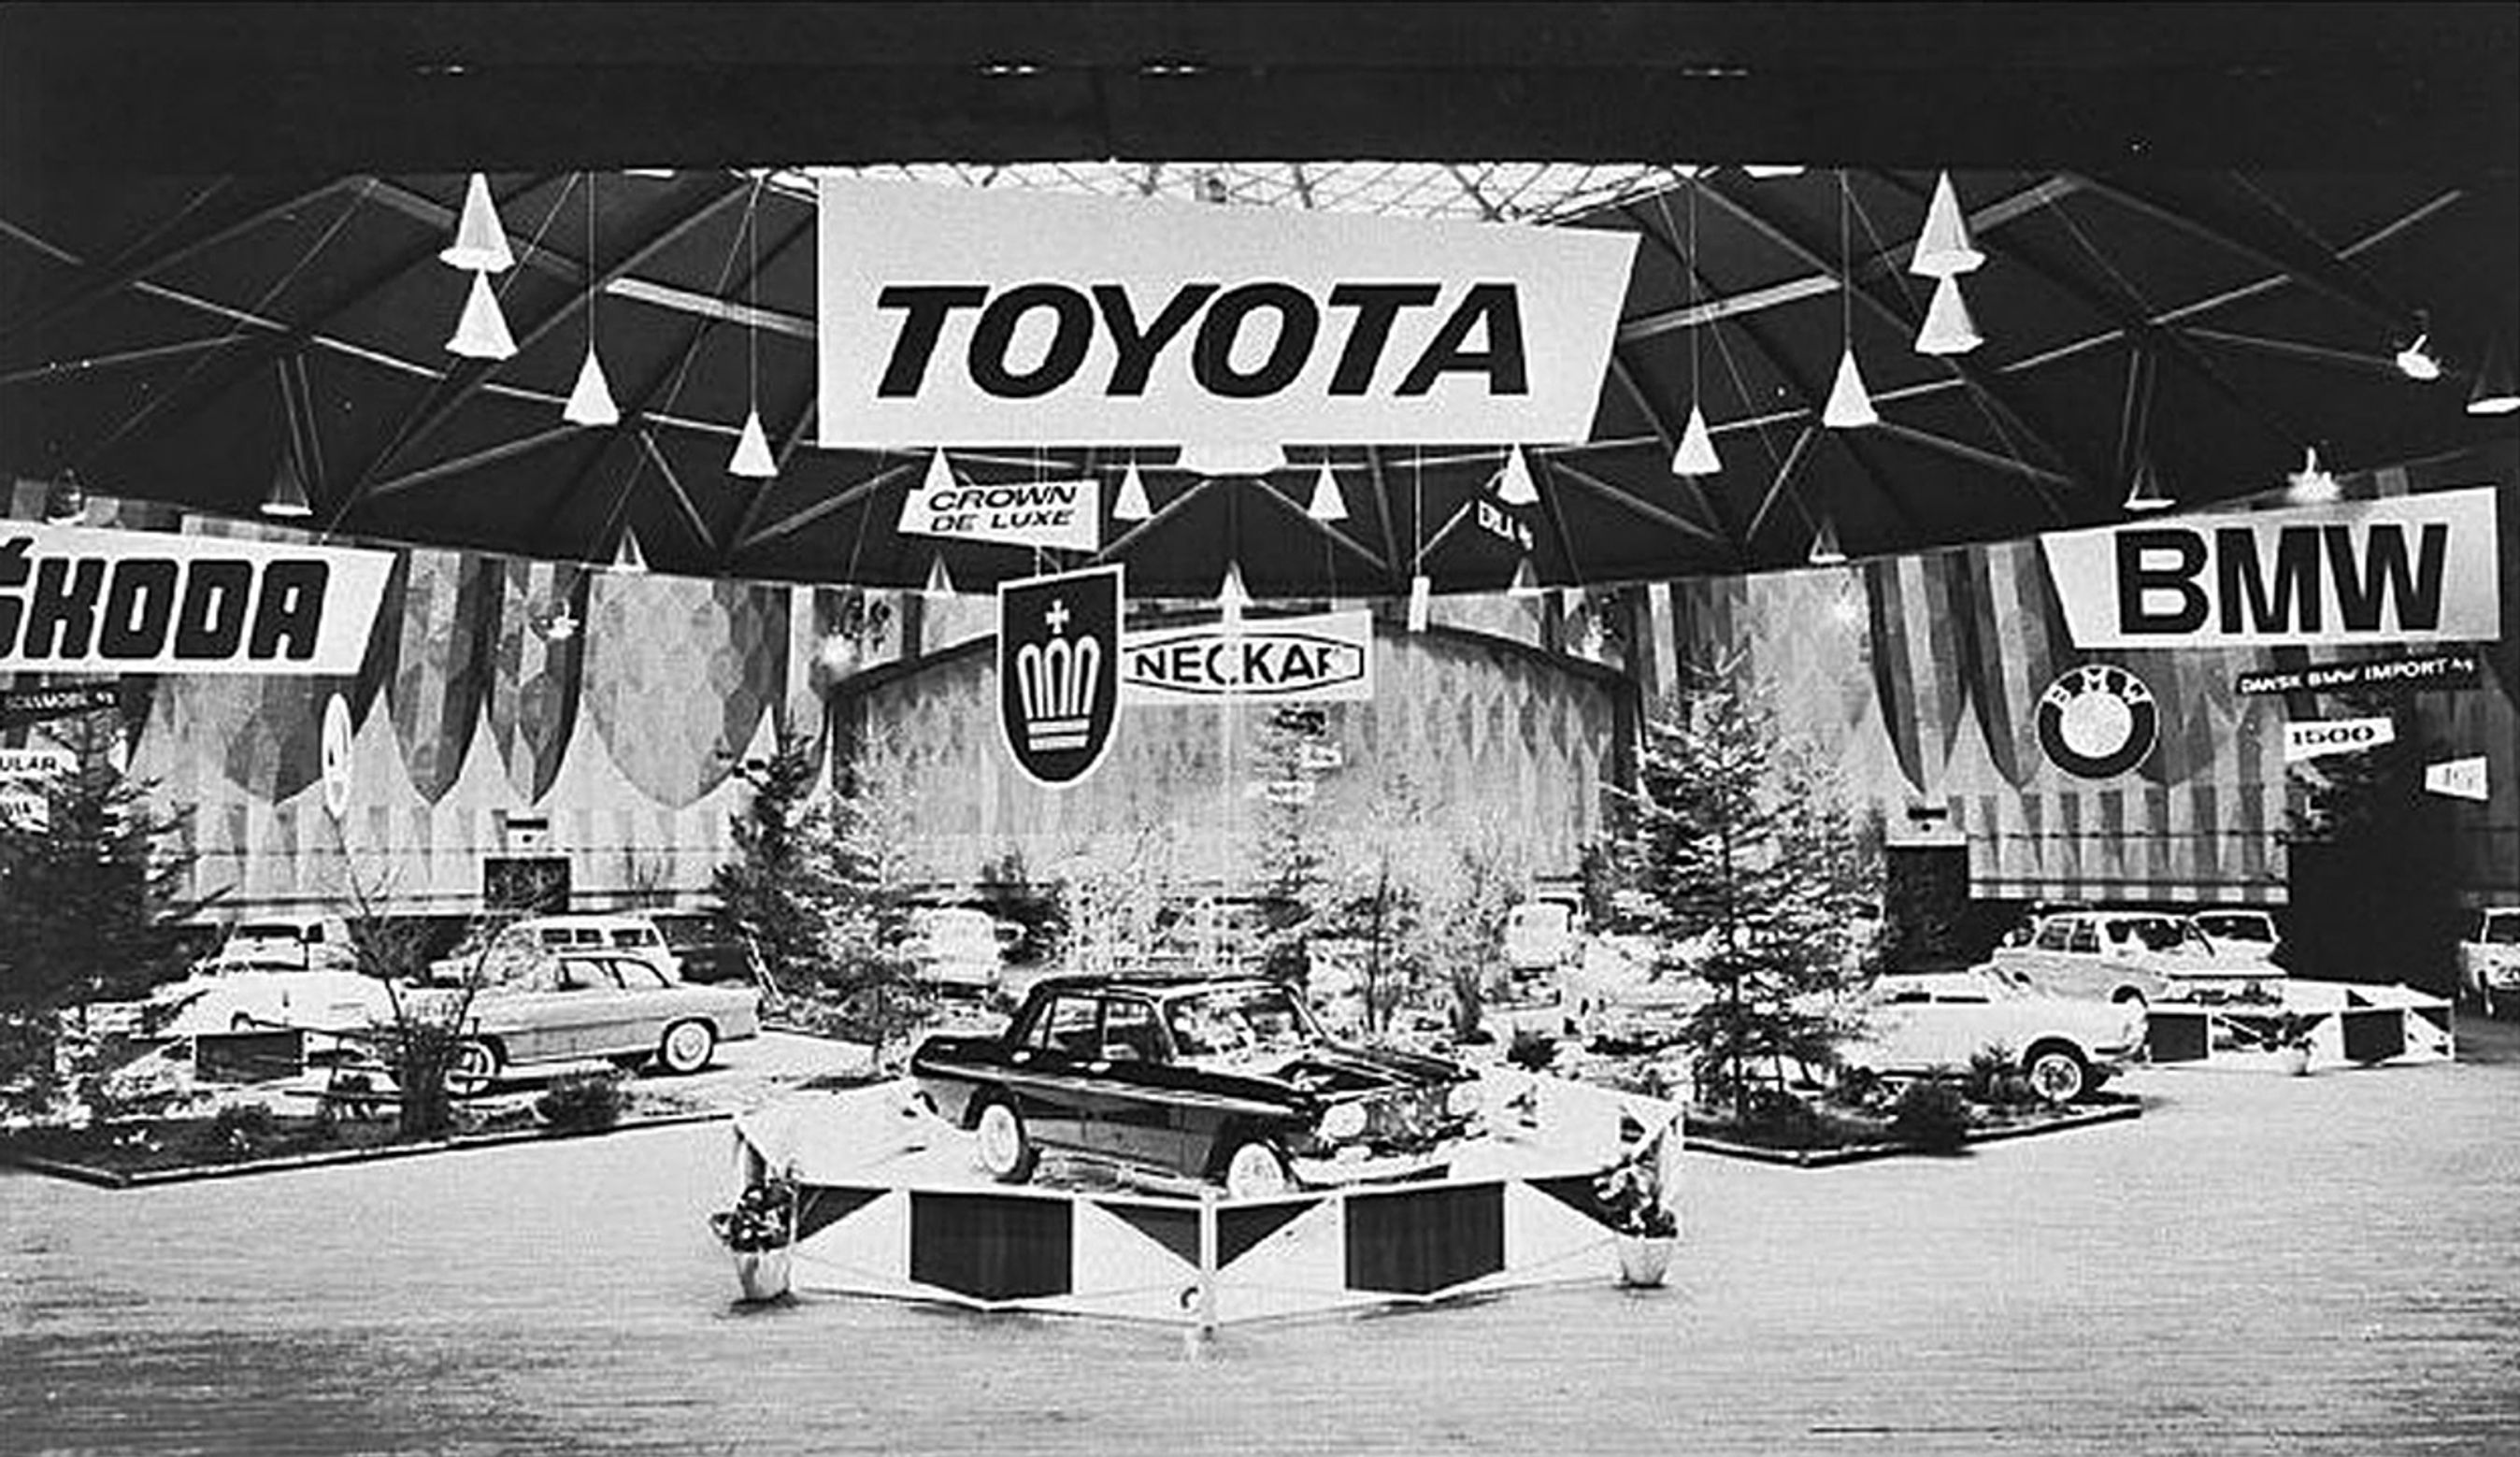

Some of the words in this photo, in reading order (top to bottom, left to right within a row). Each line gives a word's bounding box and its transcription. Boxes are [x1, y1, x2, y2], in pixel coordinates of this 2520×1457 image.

[876, 282, 1530, 400] TOYOTA
[928, 485, 1078, 511] CROWN
[931, 515, 979, 532] DE
[990, 509, 1075, 530] LUXE
[2115, 523, 2449, 635] BMW
[2365, 658, 2449, 681] IMPORT
[2041, 664, 2153, 710] BMW
[2293, 725, 2375, 746] 1500
